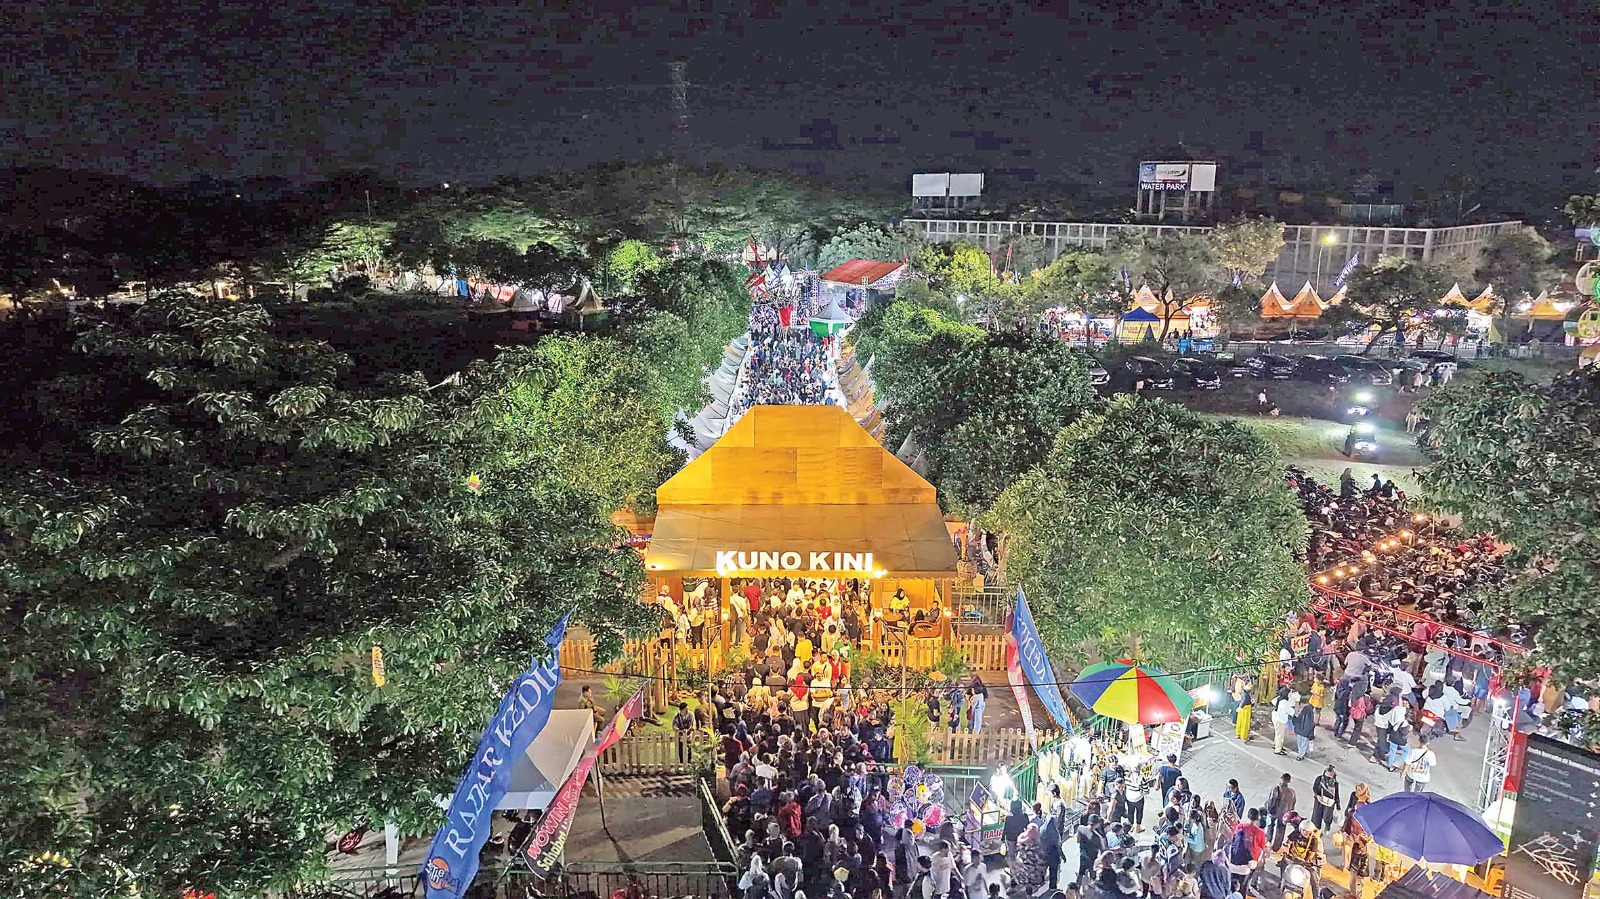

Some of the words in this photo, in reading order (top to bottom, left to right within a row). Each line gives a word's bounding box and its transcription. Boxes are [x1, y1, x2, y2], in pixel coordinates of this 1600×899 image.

[1141, 182, 1165, 191] WATER
[1166, 182, 1187, 191] PARK
[716, 550, 802, 571] KUNO
[809, 551, 874, 571] KINI
[444, 746, 503, 859] RADAR
[495, 648, 559, 748] KEDIR
[527, 802, 569, 860] WOWIN
